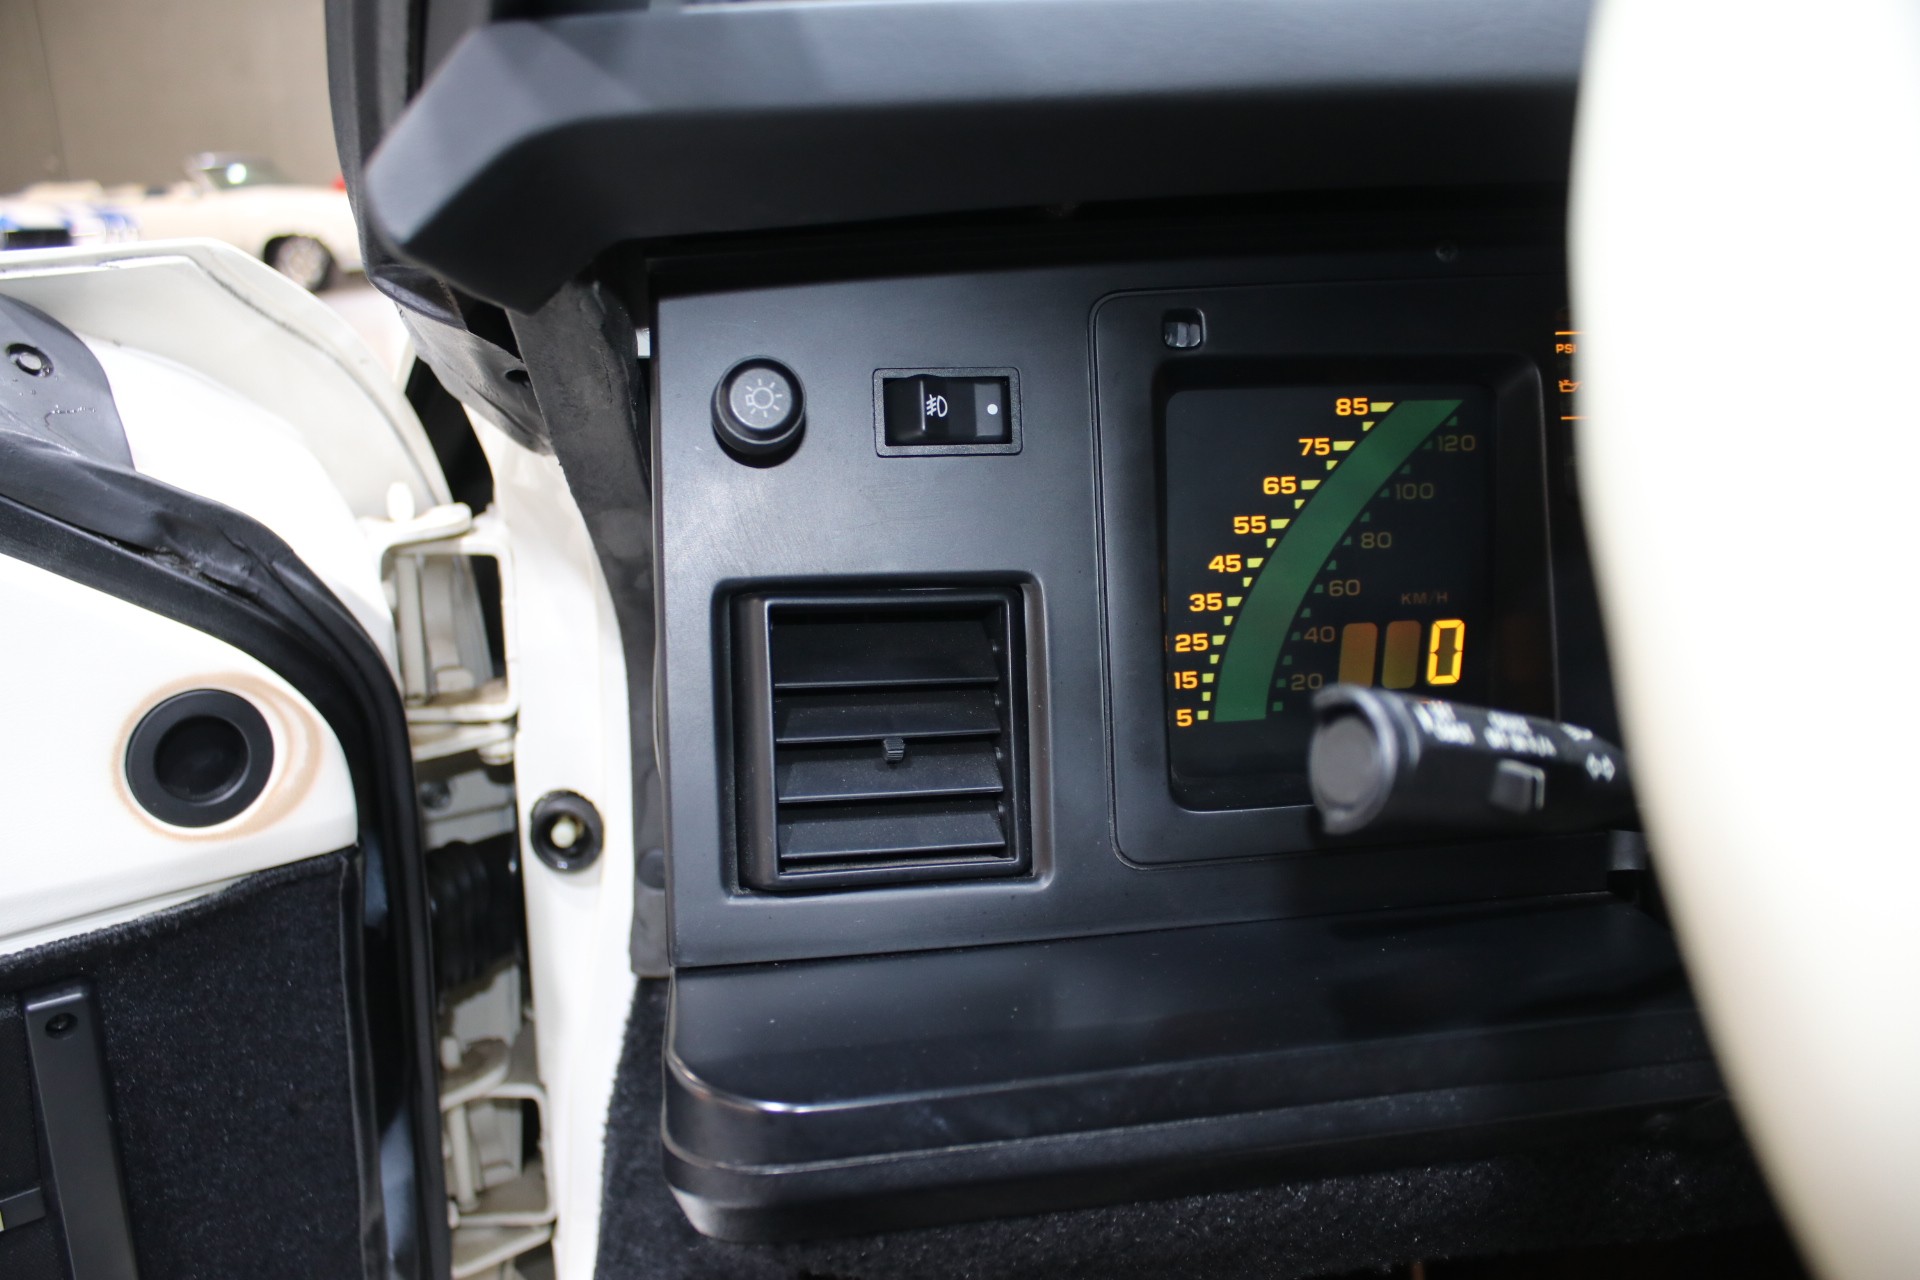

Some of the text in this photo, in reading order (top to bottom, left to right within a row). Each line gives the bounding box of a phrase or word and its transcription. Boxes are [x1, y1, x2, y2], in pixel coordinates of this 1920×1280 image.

[1335, 397, 1369, 416] 85
[1298, 437, 1330, 456] 75
[1437, 434, 1476, 452] 120
[1262, 476, 1297, 495] 65
[1395, 482, 1435, 500] 100
[1233, 515, 1267, 534] 55
[1360, 531, 1392, 549] 80
[1208, 554, 1241, 573] 45
[1329, 579, 1361, 597] 60
[1189, 593, 1223, 612] 35
[1401, 591, 1448, 605] KM/H
[1175, 633, 1209, 652] 25
[1304, 626, 1335, 644] 40
[1426, 618, 1465, 686] 0
[1173, 671, 1198, 689] 15
[1291, 673, 1323, 691] 20
[1176, 709, 1193, 728] 5
